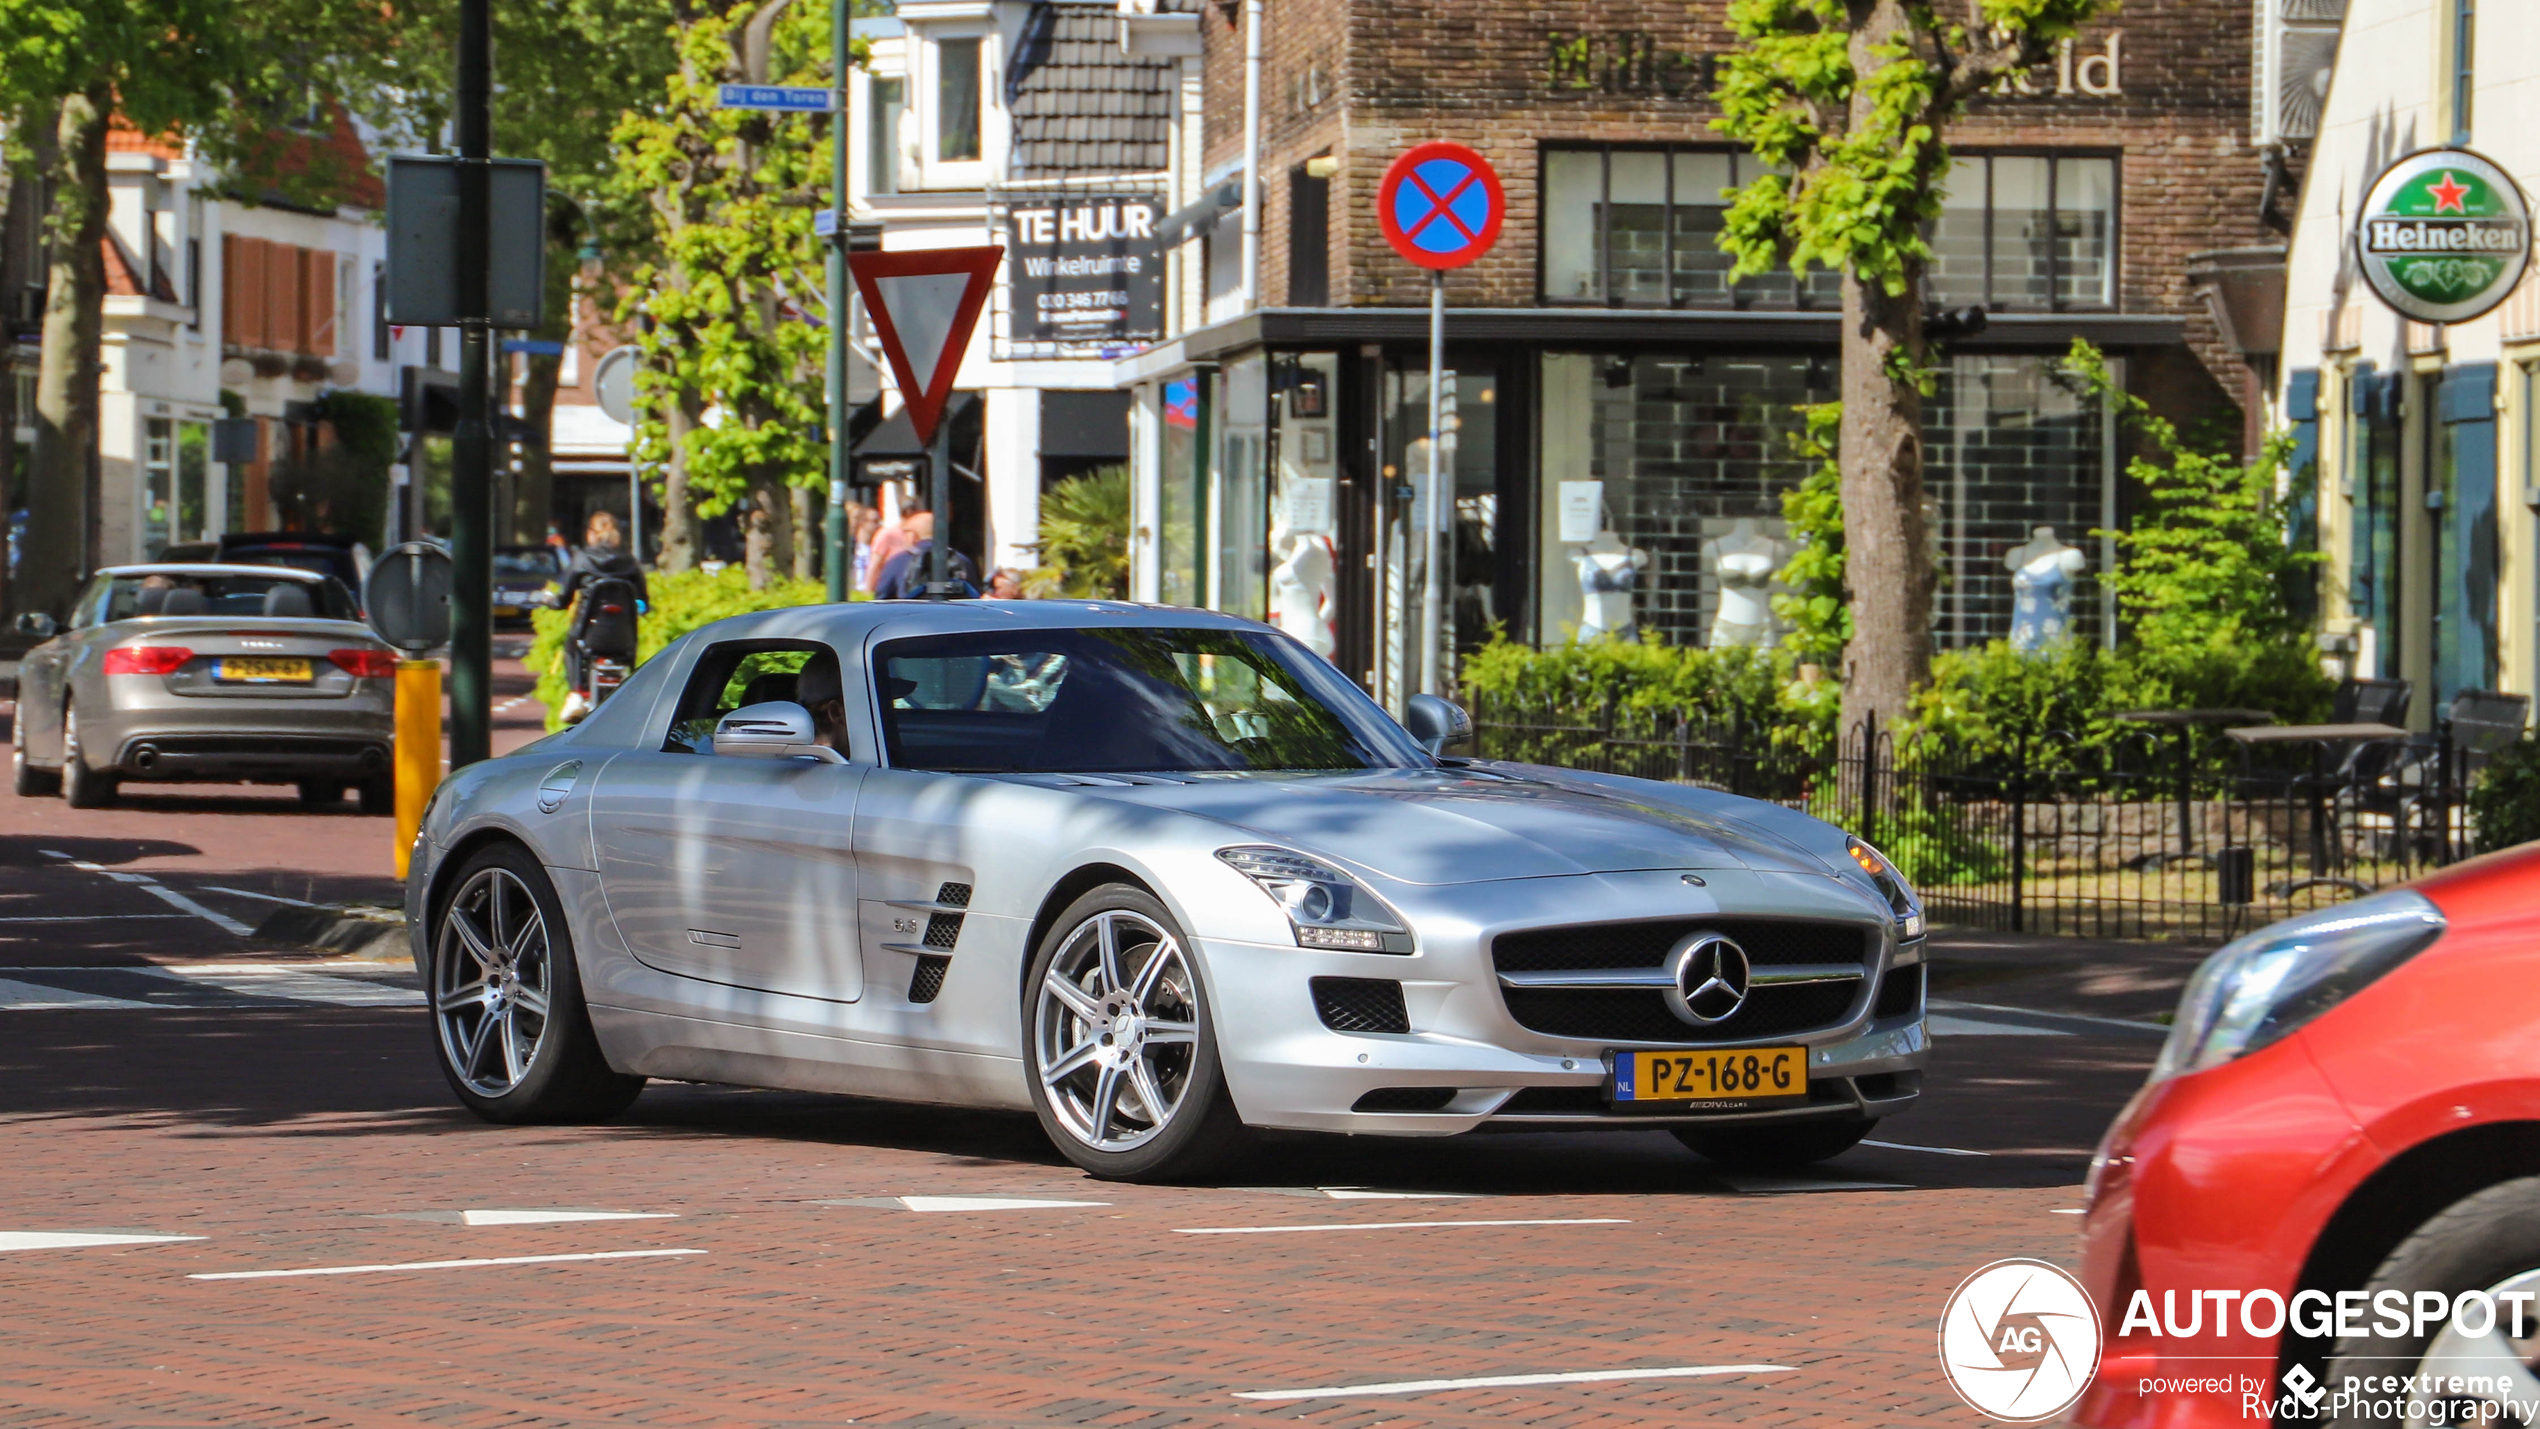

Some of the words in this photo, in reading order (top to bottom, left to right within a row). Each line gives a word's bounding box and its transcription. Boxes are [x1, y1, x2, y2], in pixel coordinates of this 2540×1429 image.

[725, 87, 746, 104] Bij
[751, 90, 779, 102] den
[783, 90, 826, 104] Toren
[1012, 208, 1056, 244] TE
[1060, 204, 1153, 242] HUUR
[2371, 221, 2519, 250] Heineken
[1024, 254, 1142, 278] Winkelruimte
[1652, 1053, 1791, 1094] PZ-168-G
[1617, 1081, 1632, 1093] NL
